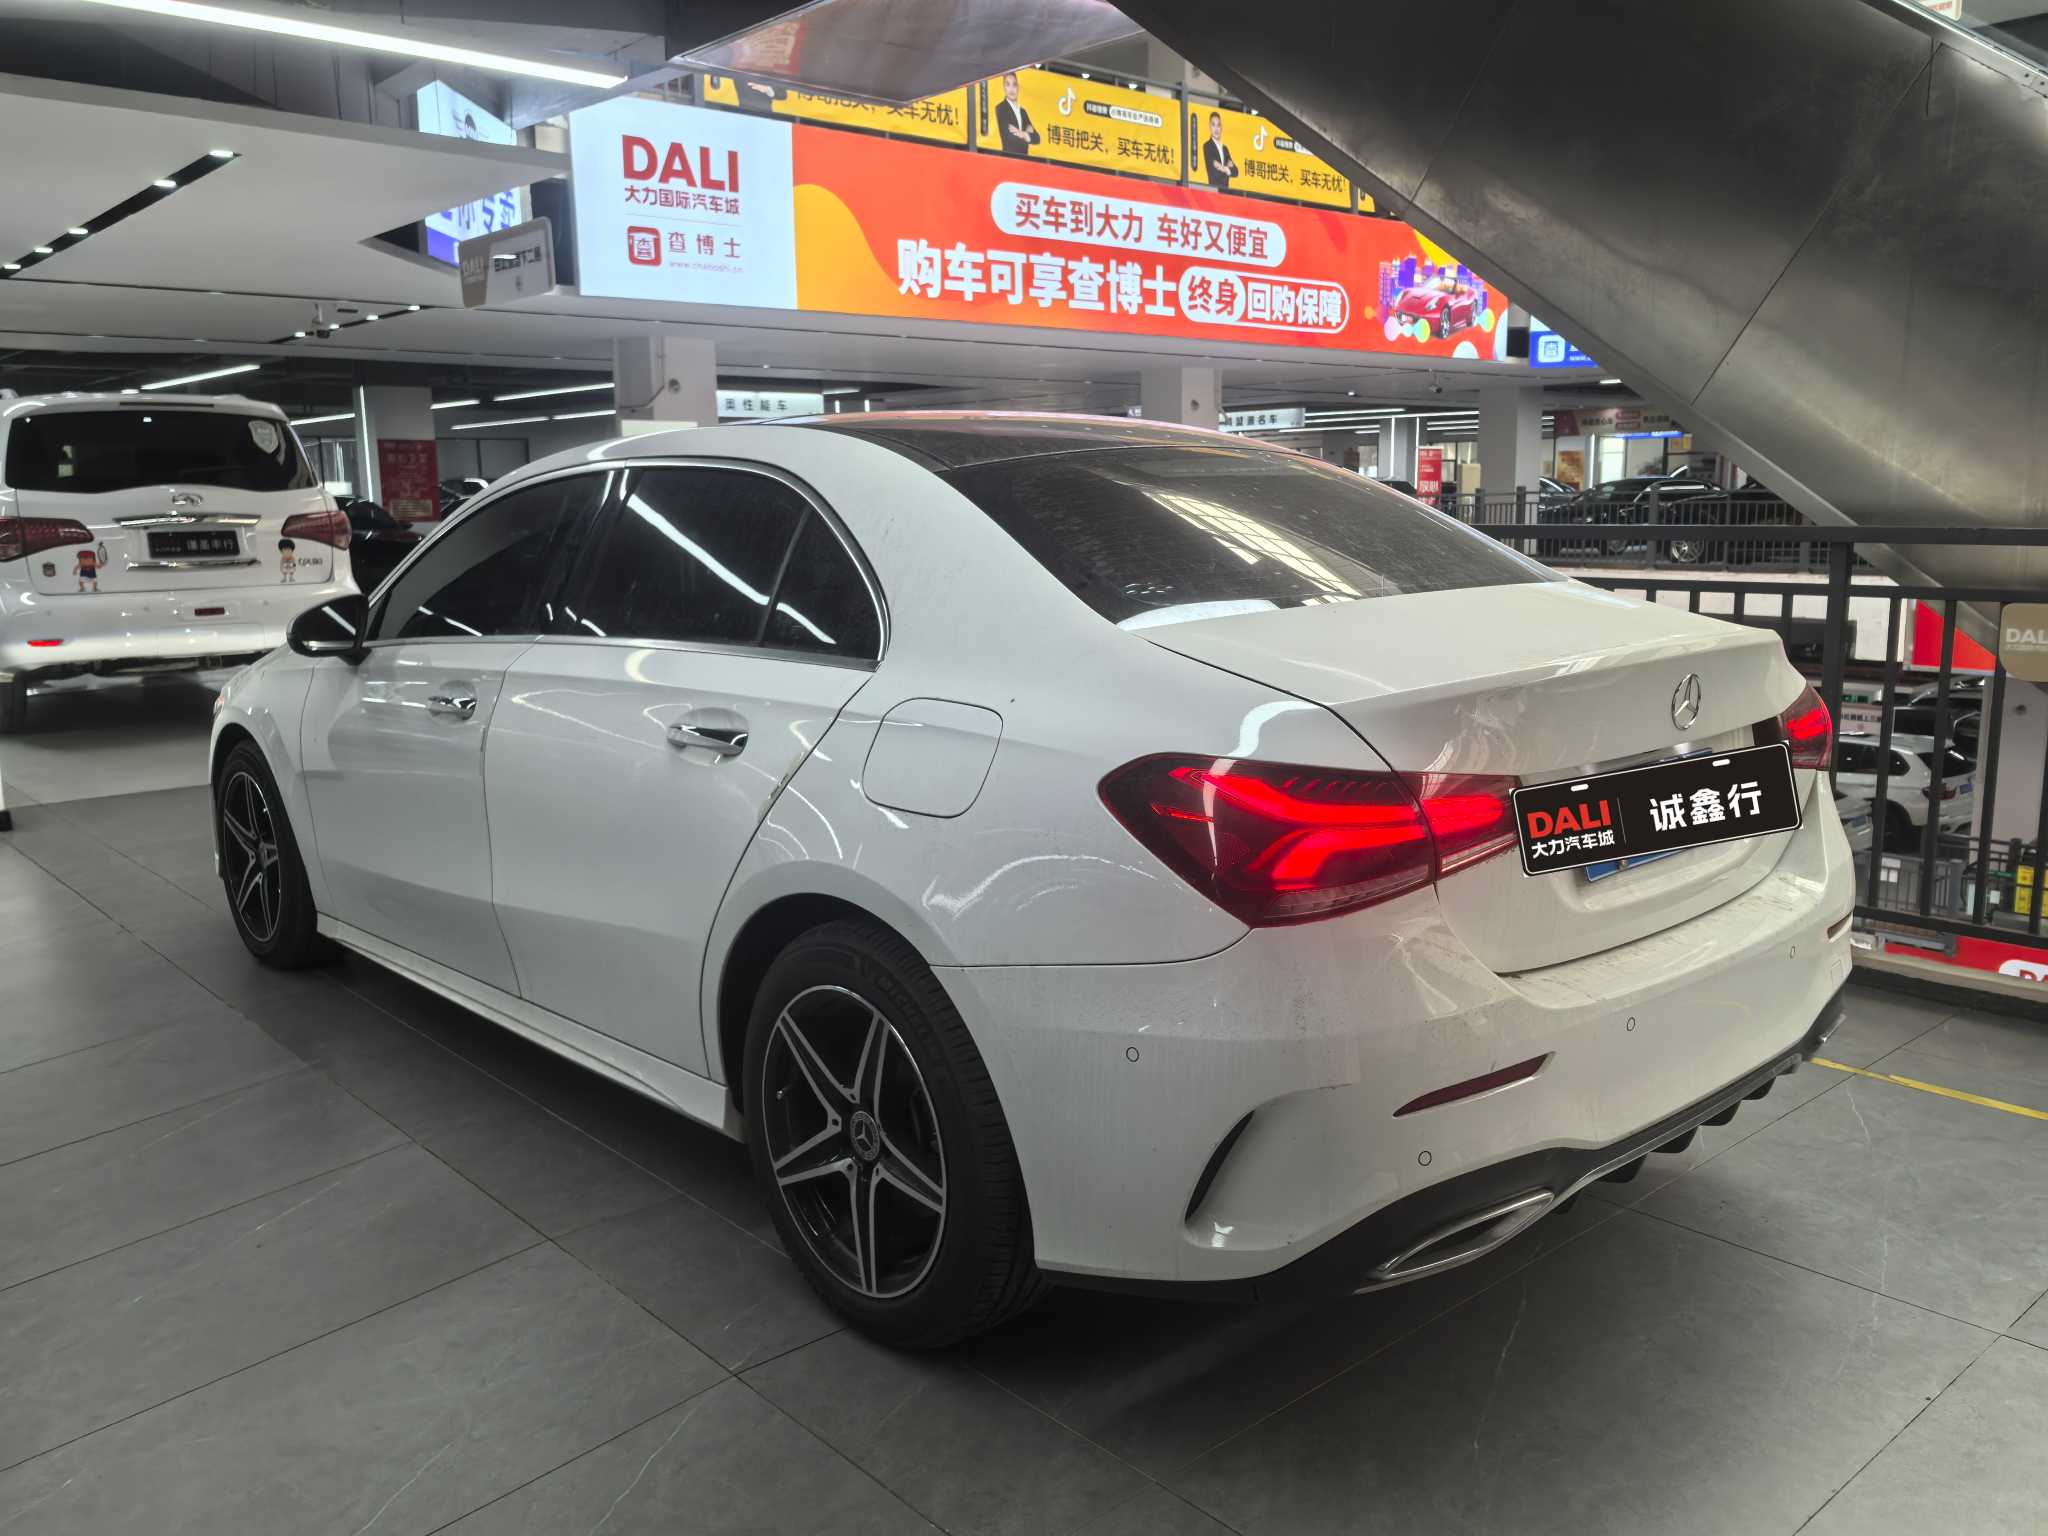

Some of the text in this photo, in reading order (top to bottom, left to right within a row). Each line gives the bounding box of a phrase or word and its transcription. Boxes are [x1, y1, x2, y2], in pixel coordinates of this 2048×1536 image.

[622, 134, 739, 193] DALI
[624, 185, 740, 215] 大力国际汽车城
[667, 231, 741, 258] 查博士
[1014, 192, 1269, 260] 买车到大力 车好又便宜
[897, 238, 1343, 327] 购车可享查博士 终身 回购保障
[1527, 799, 1613, 839] DALI
[1649, 781, 1762, 832] 诚鑫行
[1531, 829, 1616, 859] 大力汽车城
